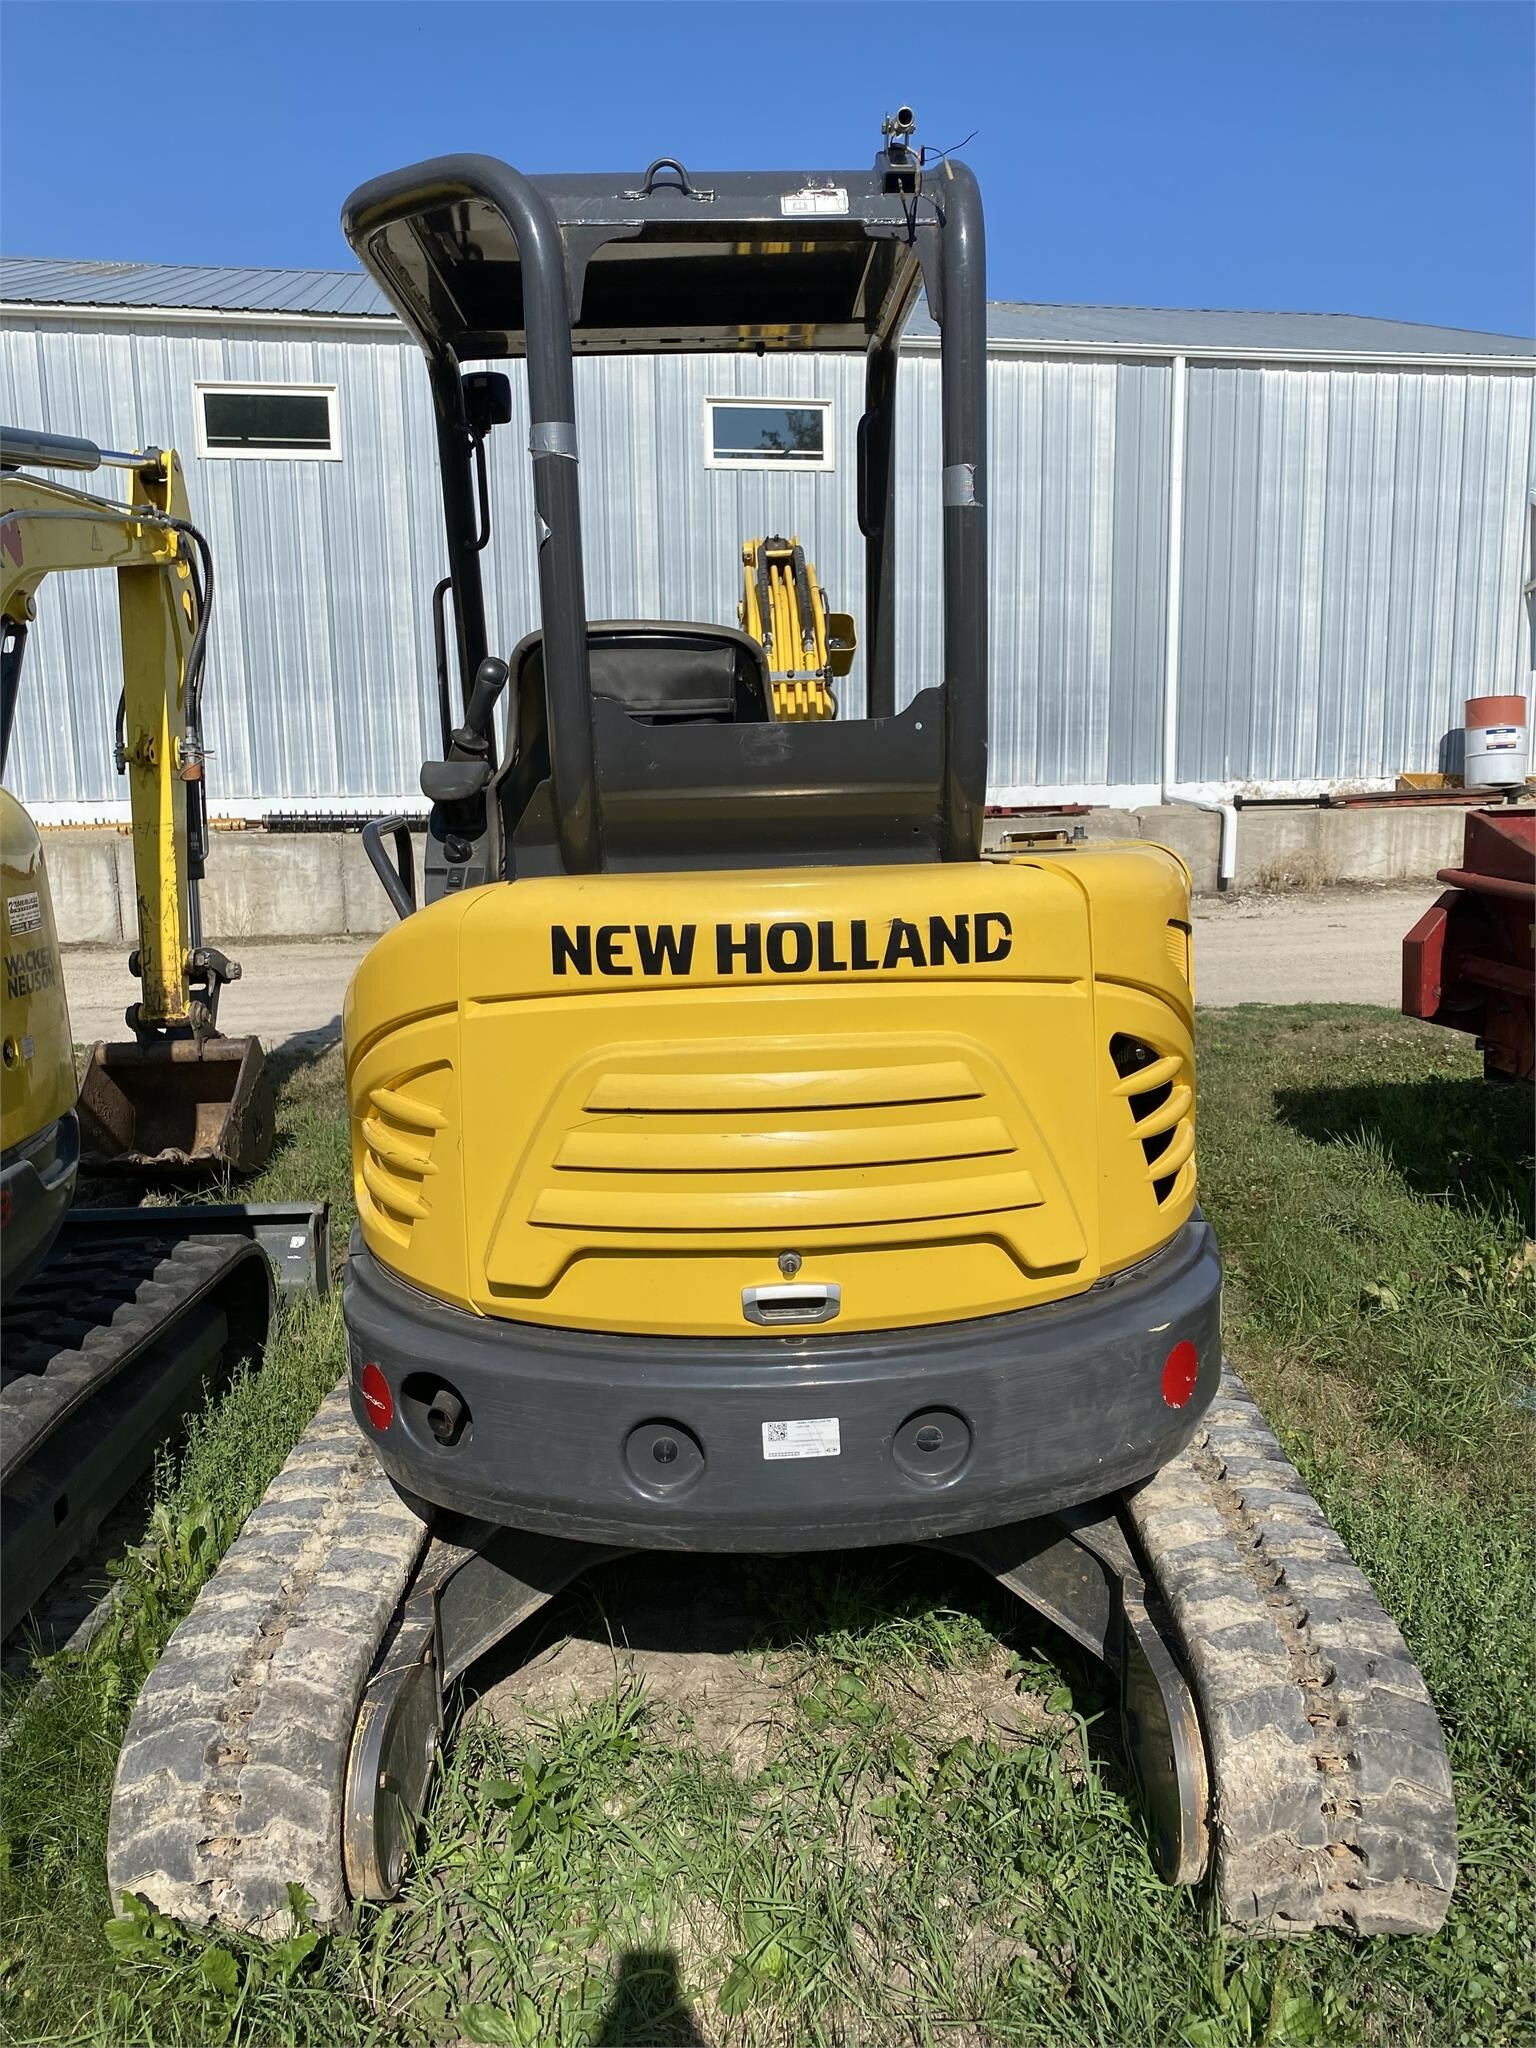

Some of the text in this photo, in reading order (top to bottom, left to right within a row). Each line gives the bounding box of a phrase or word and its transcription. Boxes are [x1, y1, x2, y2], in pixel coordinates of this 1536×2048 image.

[550, 912, 1013, 976] NEW HOLLAND
[4, 947, 52, 977] WACKER
[7, 967, 56, 1000] NEUSON
